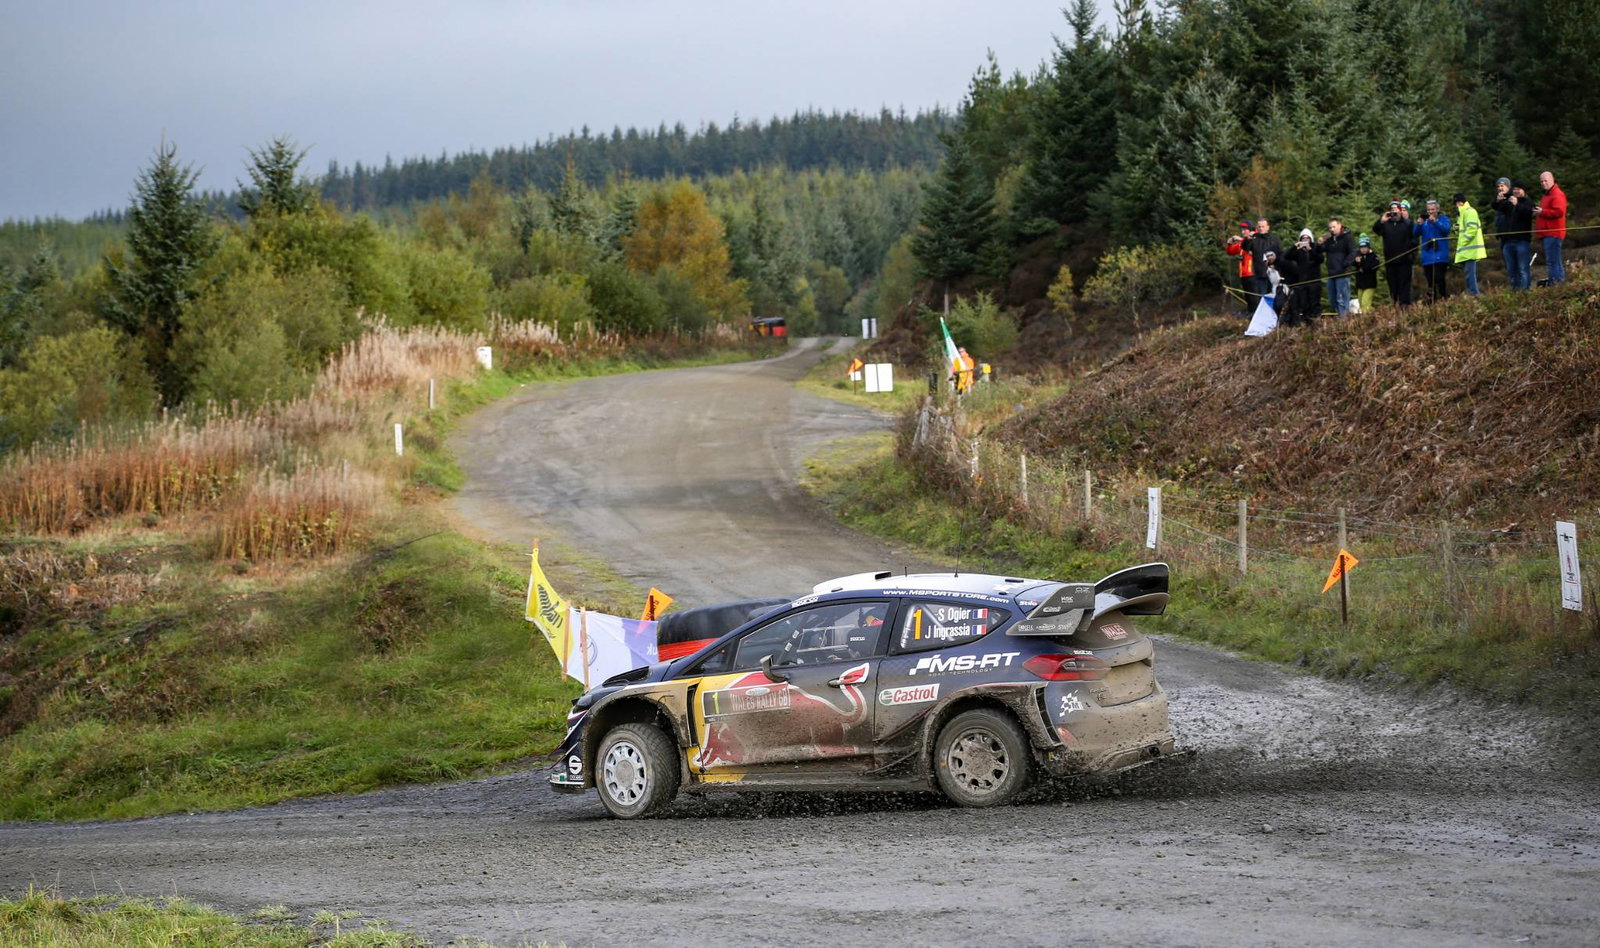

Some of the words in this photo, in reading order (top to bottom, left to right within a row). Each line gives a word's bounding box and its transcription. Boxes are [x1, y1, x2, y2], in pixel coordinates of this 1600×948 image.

[883, 589, 1009, 604] www.MSPORTSTORE.com
[937, 608, 945, 622] S
[947, 607, 971, 623] Ogier
[913, 608, 923, 640] 1
[924, 625, 931, 639] J
[933, 623, 970, 640] Ingrassia
[928, 652, 1020, 673] MS-RT
[949, 668, 993, 676] TECHNOLOGY
[712, 692, 720, 714] 1
[730, 693, 755, 711] WALES
[756, 692, 777, 709] RALLY
[893, 686, 935, 703] Castrol
